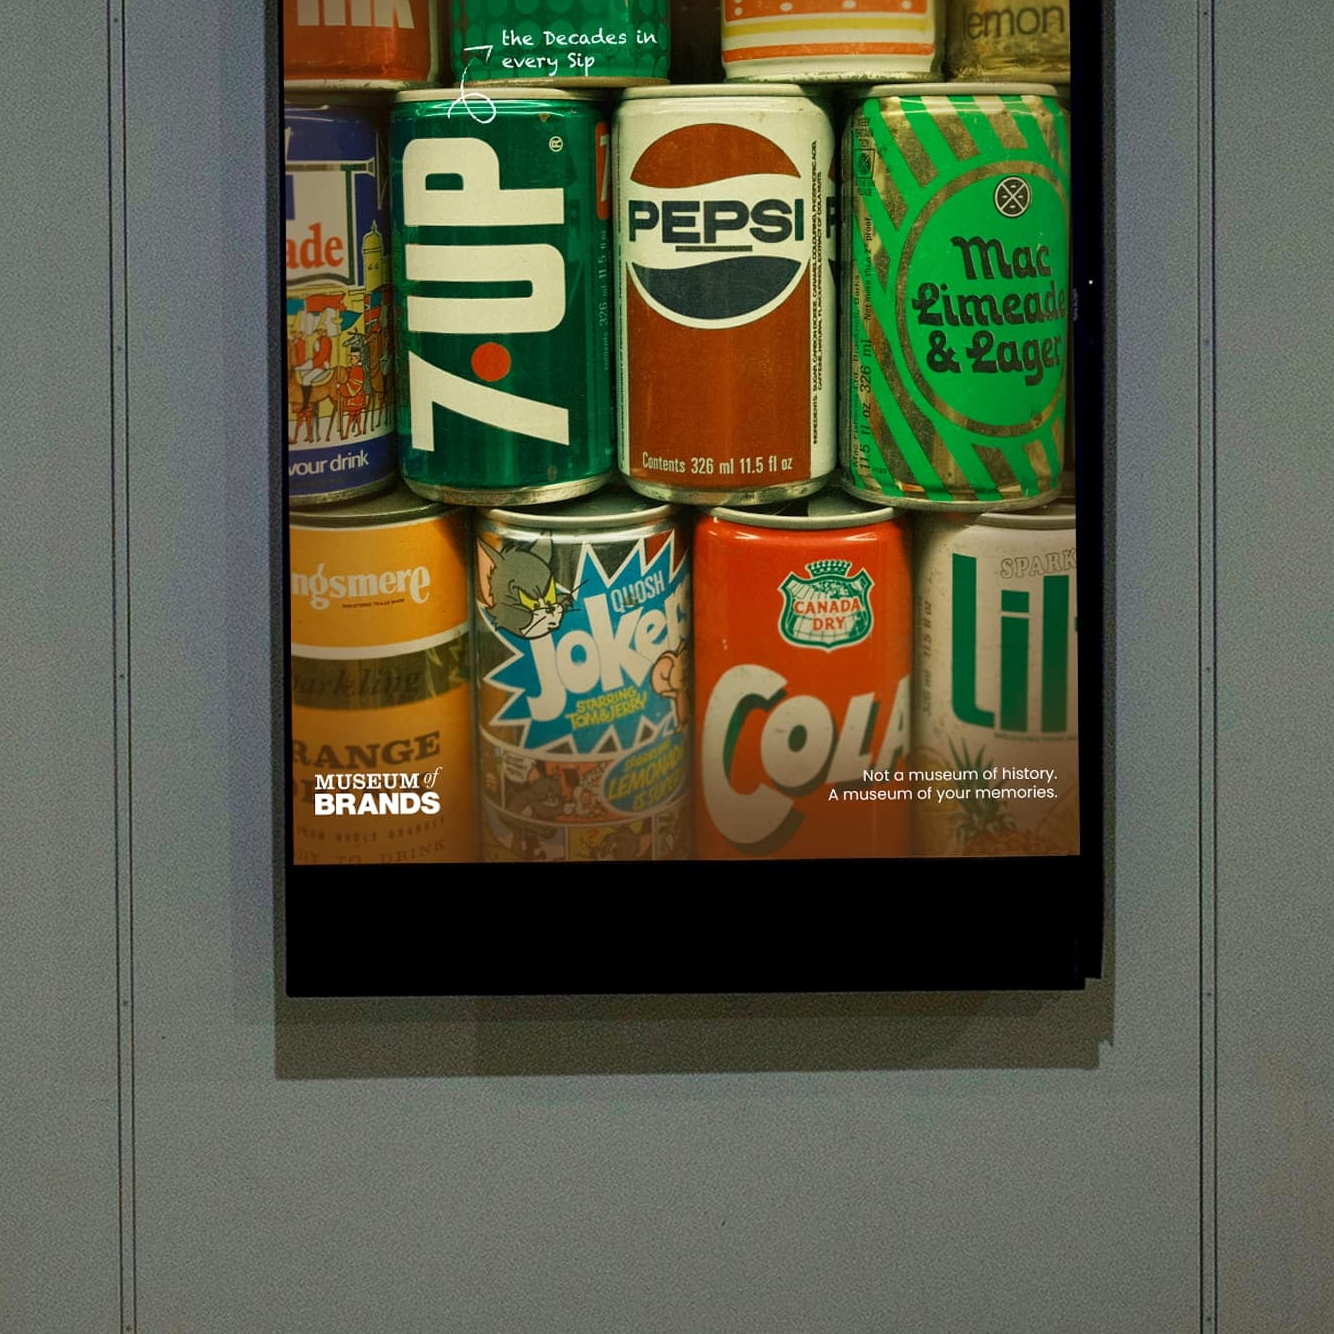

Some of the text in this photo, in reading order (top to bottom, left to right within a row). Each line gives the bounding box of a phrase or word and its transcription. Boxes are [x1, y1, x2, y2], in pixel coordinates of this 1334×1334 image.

[962, 5, 1065, 40] lemon
[502, 28, 658, 46] the Decades in
[502, 52, 595, 77] every Sip
[629, 199, 805, 244] PEPSI
[950, 236, 1052, 280] Mac
[912, 280, 1066, 326] Limeade
[926, 330, 1062, 386] & Lager
[860, 366, 871, 393] 326
[329, 449, 369, 472] drink
[642, 451, 793, 475] Contents 326 ml 11.5 fl oz
[611, 570, 665, 613] QUOSH
[794, 598, 861, 615] CANADA
[812, 617, 846, 631] DRY
[315, 766, 443, 790] MUSEUM of
[863, 767, 1058, 784] Not a museum of history.
[315, 791, 441, 816] BRANDS
[828, 785, 1058, 803] A museum of your memories.
